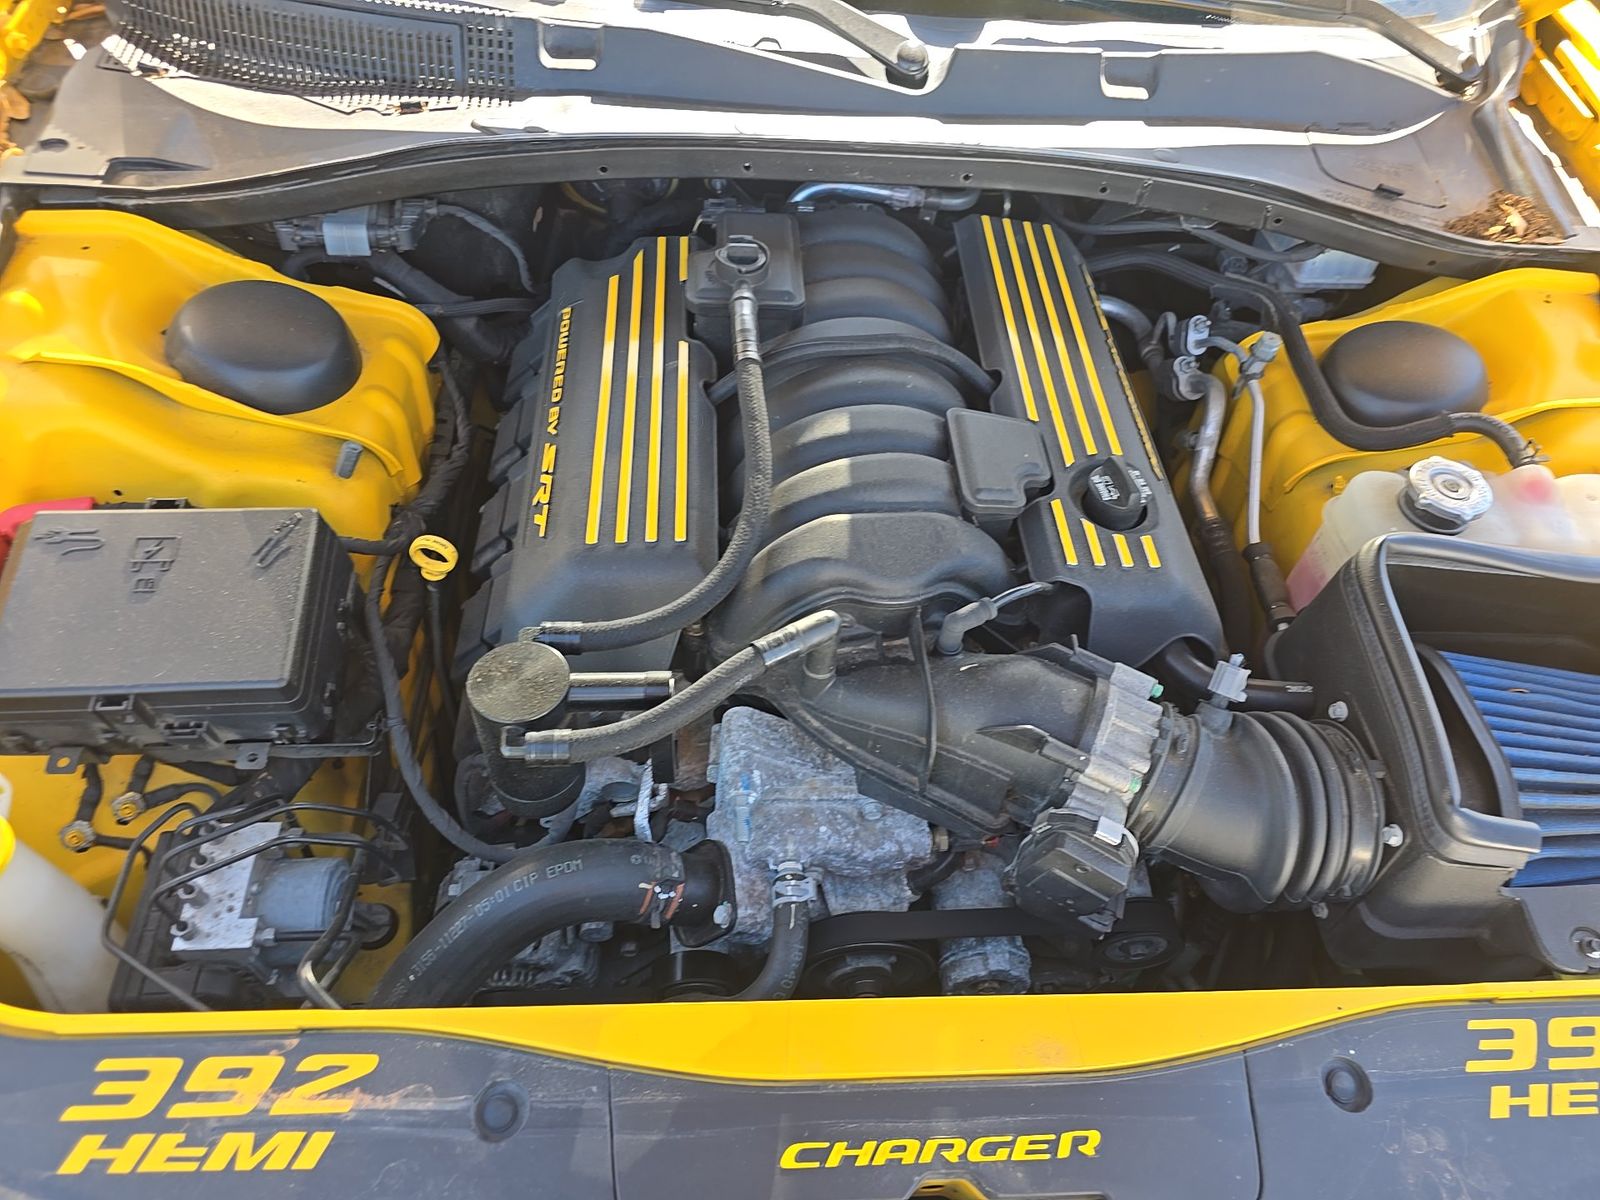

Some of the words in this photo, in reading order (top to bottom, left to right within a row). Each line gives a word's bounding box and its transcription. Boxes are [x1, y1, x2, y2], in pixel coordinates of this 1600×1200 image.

[551, 306, 572, 403] POWERED
[547, 406, 560, 435] BY
[532, 442, 557, 537] SRT
[1465, 1016, 1600, 1073] 39
[58, 1053, 380, 1122] 392
[1490, 1082, 1599, 1119] HE
[56, 1131, 336, 1175] HEMI
[779, 1129, 1102, 1169] CHARGER
